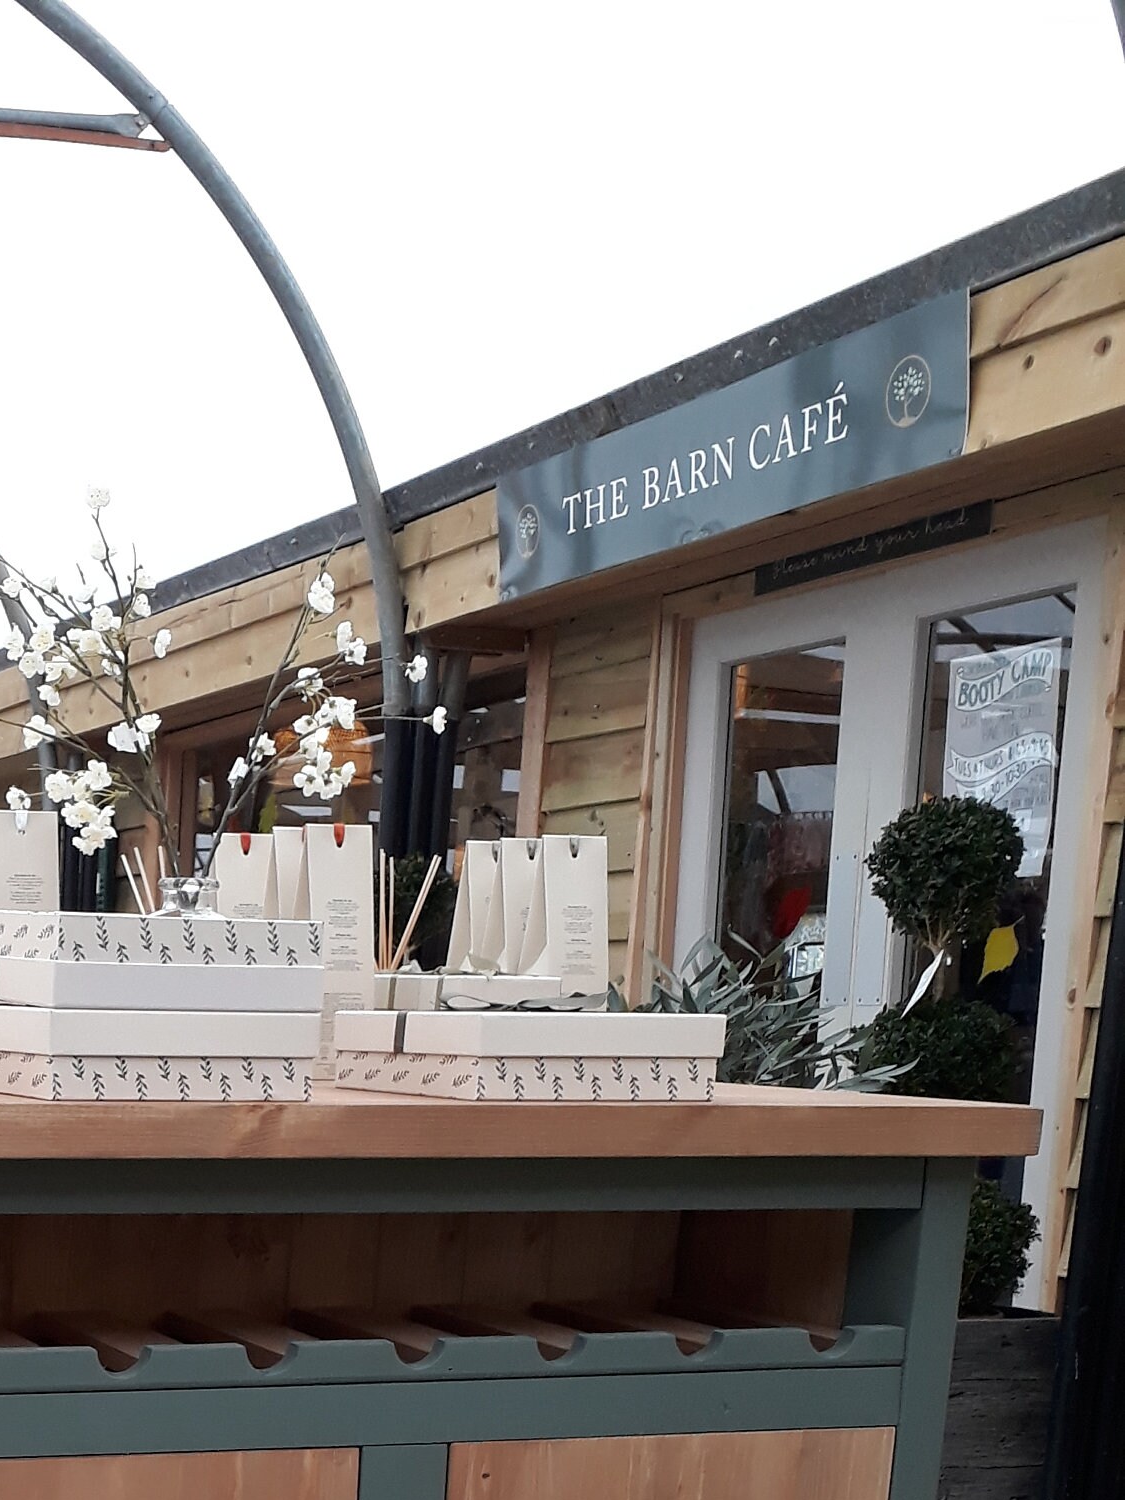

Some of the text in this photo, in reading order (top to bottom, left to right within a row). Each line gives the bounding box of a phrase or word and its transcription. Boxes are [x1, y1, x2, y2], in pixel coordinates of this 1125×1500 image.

[561, 381, 849, 535] THE BARN CAFÉ
[823, 536, 868, 561] mind
[875, 529, 920, 555] your
[925, 507, 970, 534] head
[958, 670, 1005, 707] BOOTY
[1010, 651, 1052, 682] CAMP
